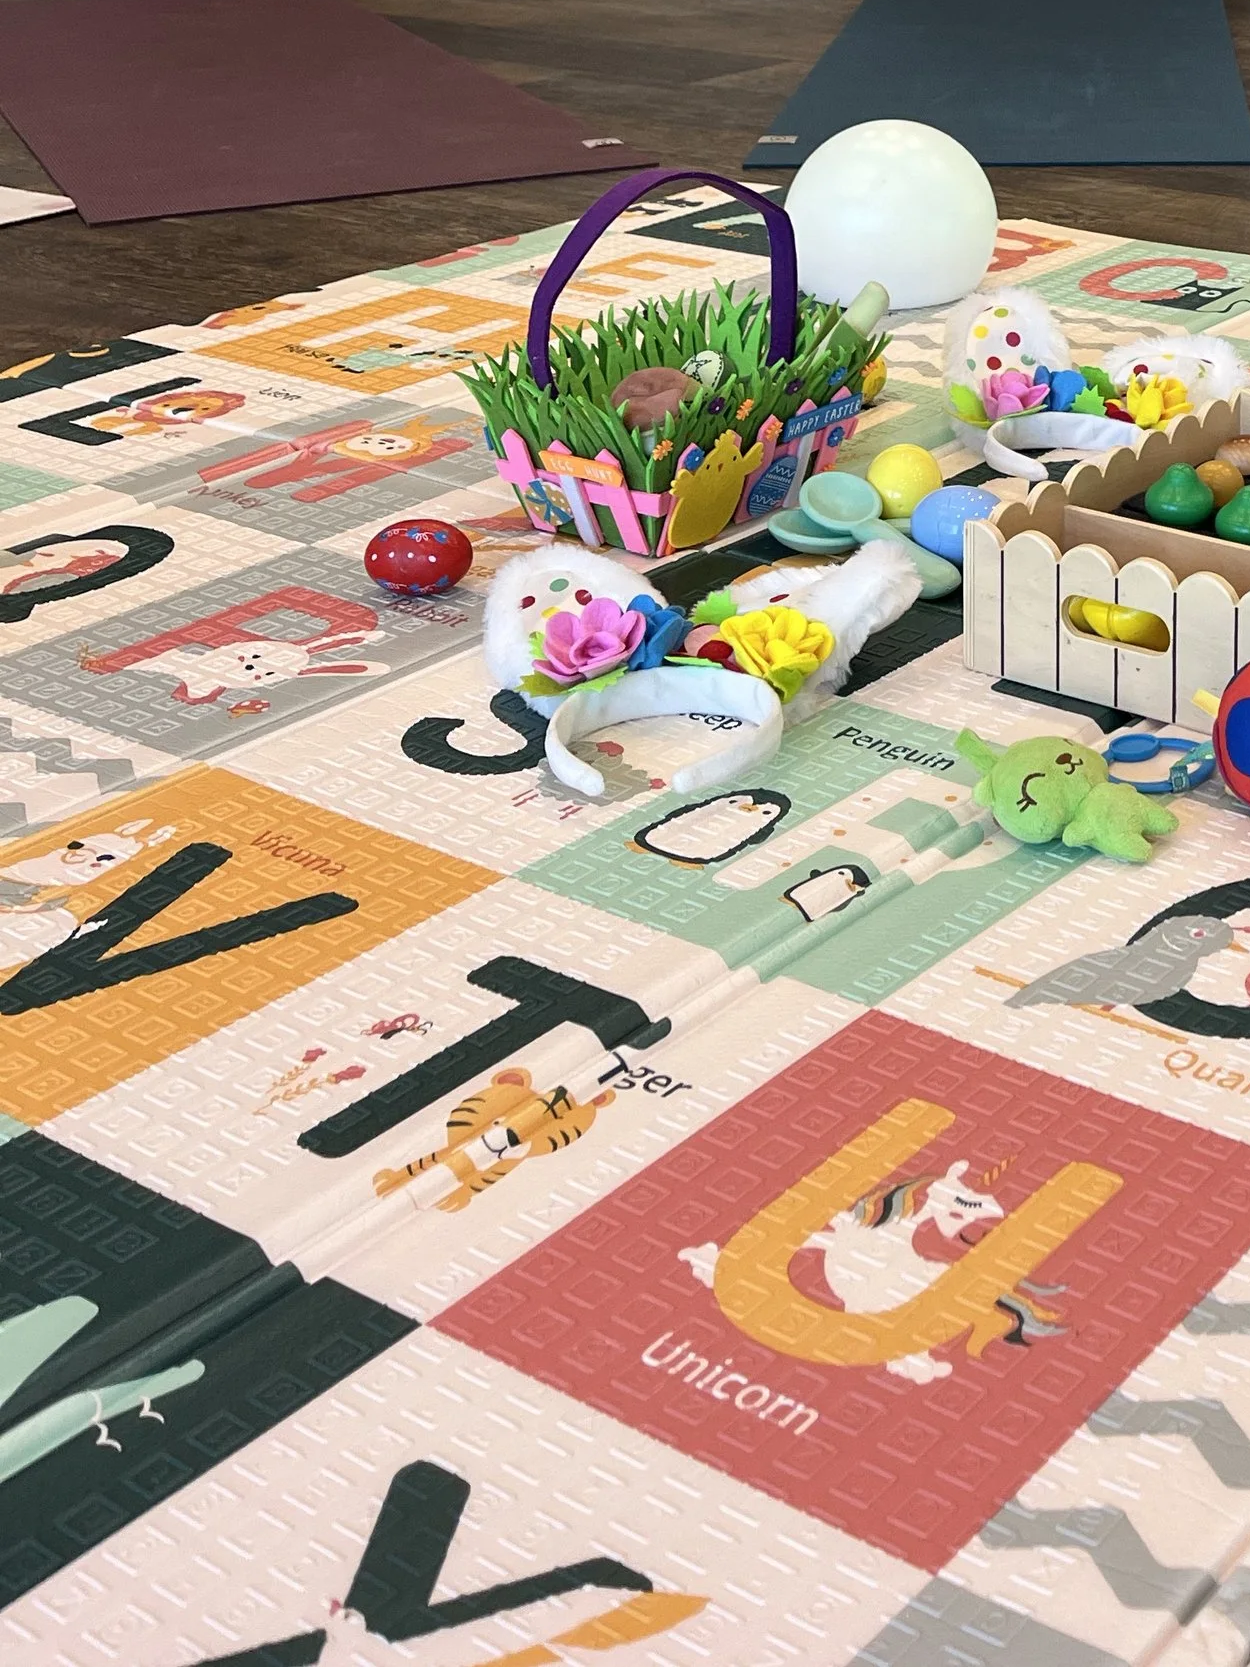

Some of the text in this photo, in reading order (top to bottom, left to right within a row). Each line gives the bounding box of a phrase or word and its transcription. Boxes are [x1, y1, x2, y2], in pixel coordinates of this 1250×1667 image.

[788, 399, 861, 437] HAPPY EASTER
[584, 464, 613, 483] HUNT
[384, 599, 470, 628] Rabbit
[832, 726, 955, 771] Penguin
[250, 830, 347, 877] Vicuna
[297, 956, 671, 1158] T
[641, 1331, 822, 1437] Unicorn
